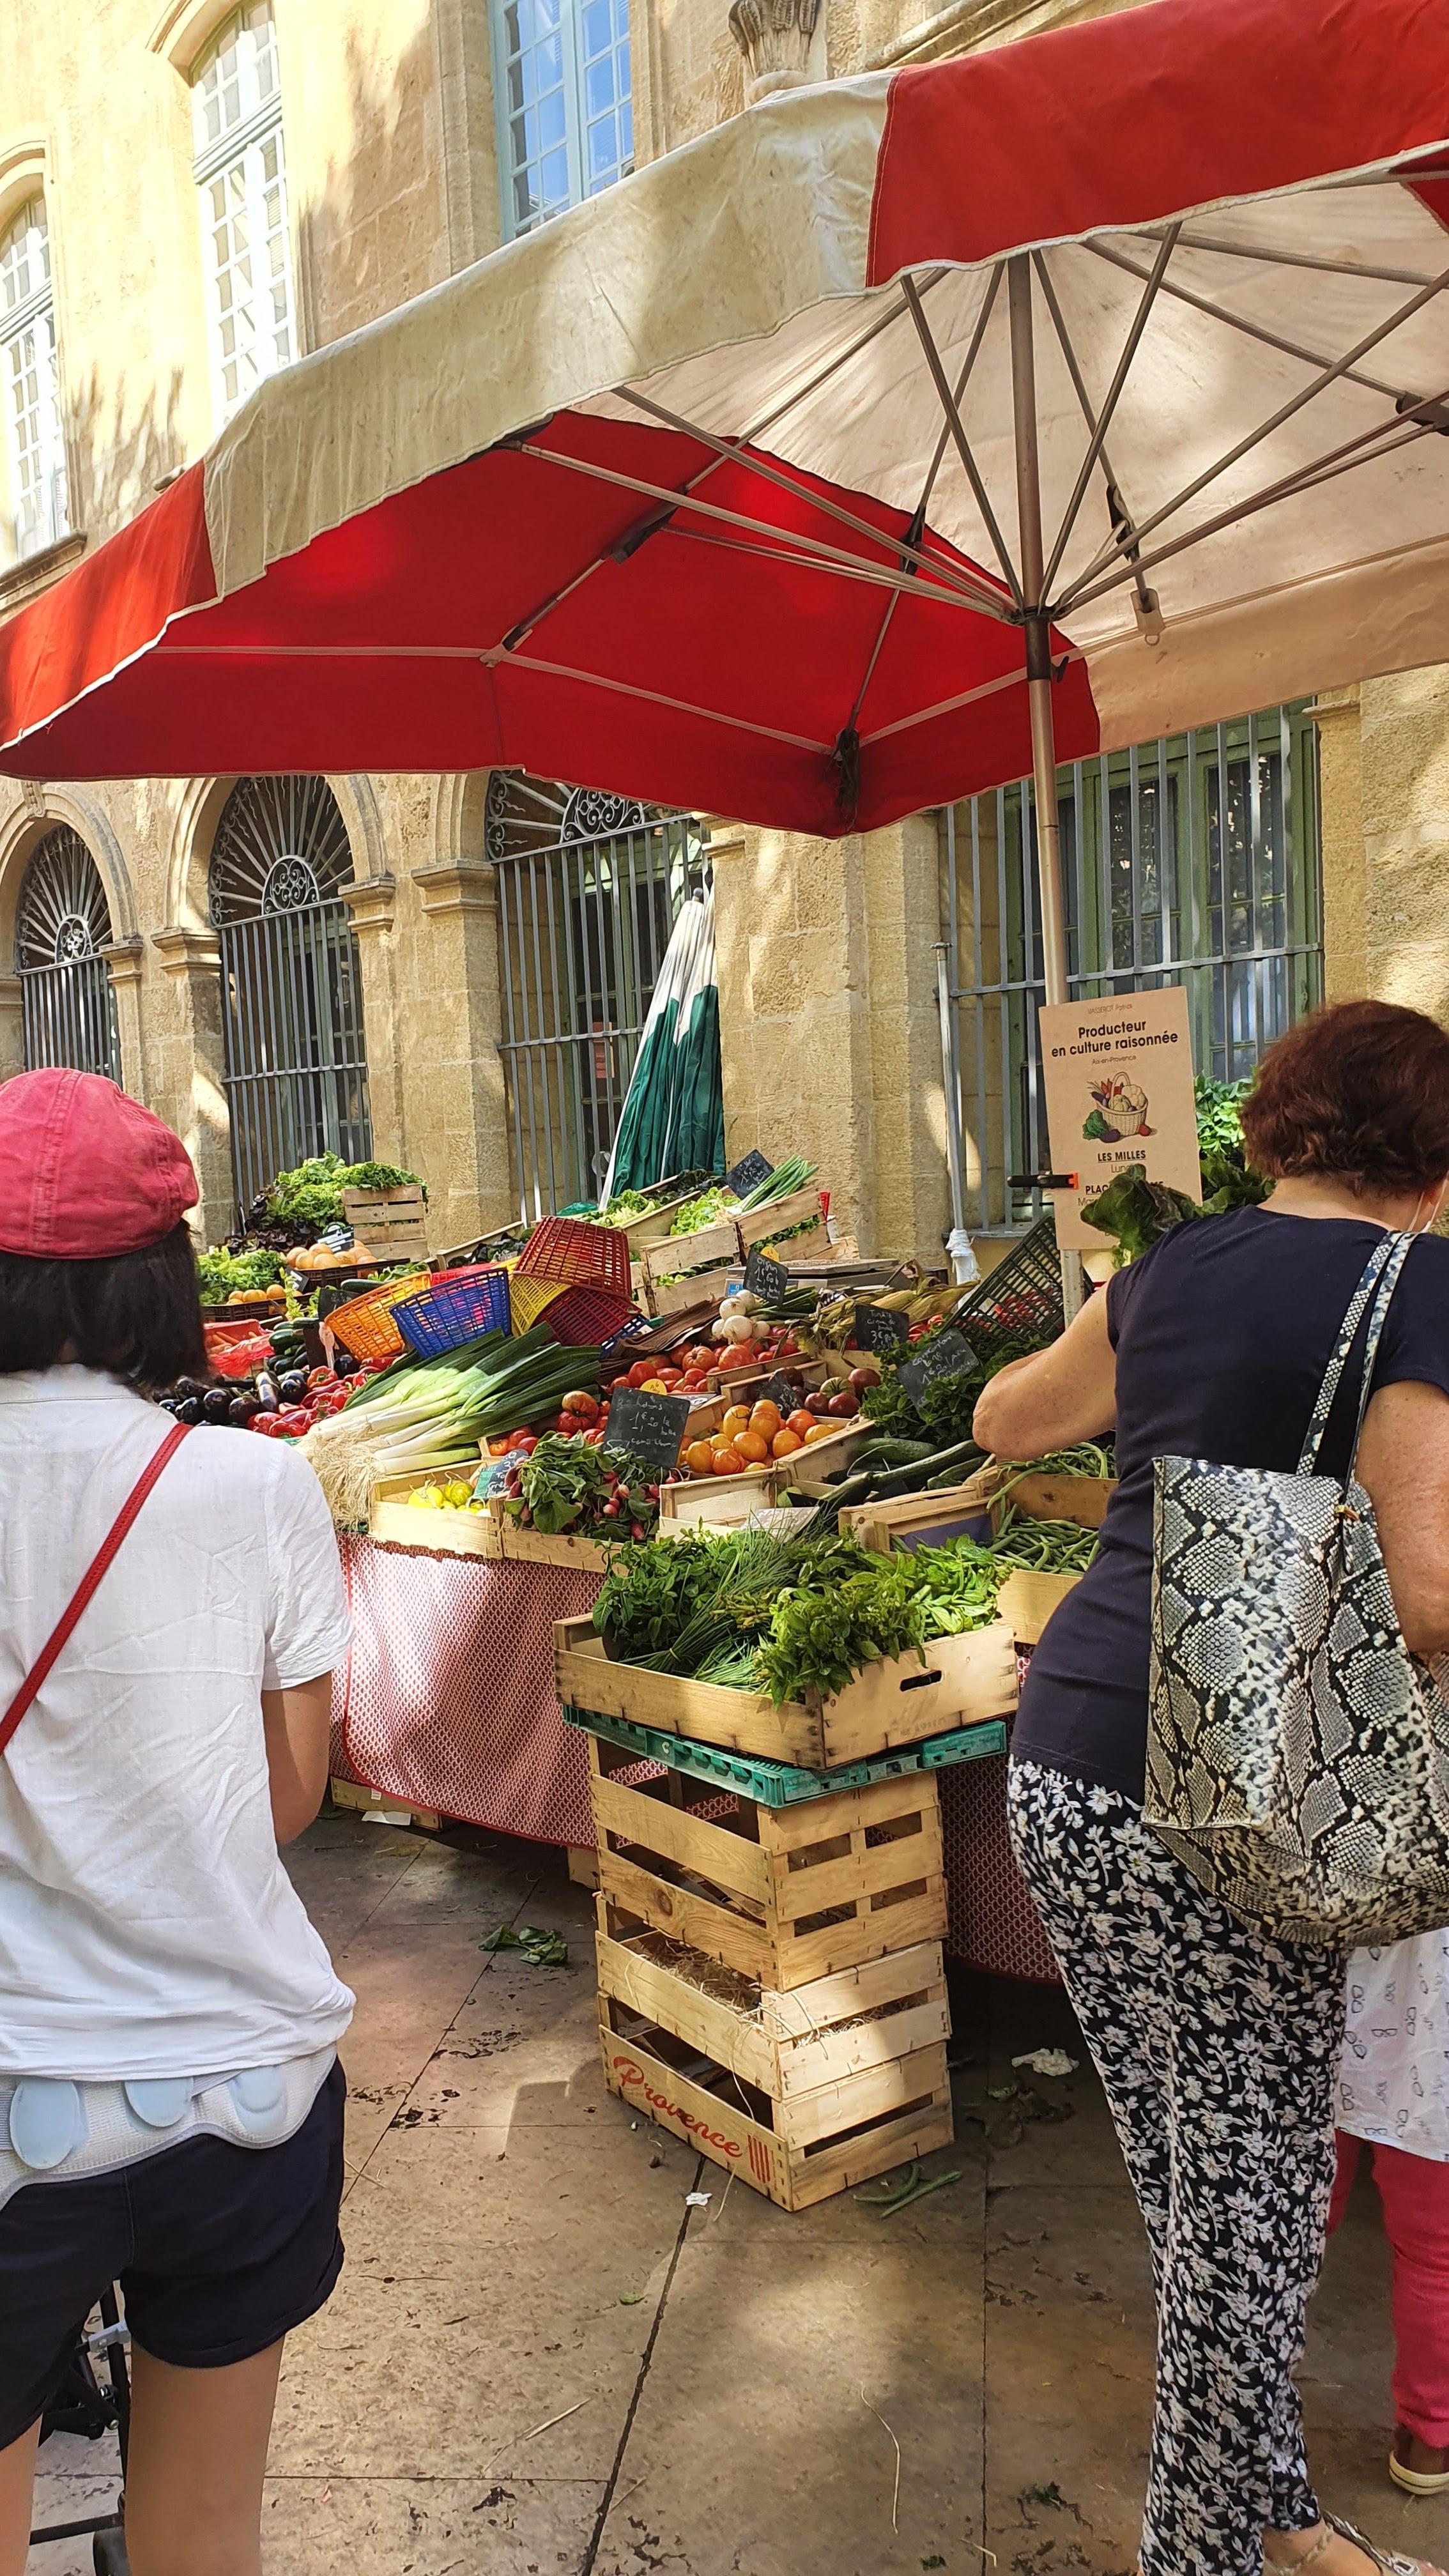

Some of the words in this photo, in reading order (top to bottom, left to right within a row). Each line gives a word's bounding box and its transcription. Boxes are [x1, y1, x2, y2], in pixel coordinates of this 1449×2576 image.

[1078, 1020, 1147, 1039] Producteur
[1051, 1047, 1066, 1057] en
[1069, 1041, 1112, 1055] culture
[1115, 1030, 1179, 1050] raisonnée
[1091, 1054, 1137, 1065] Aix-en-Provence
[1098, 1153, 1112, 1162] LES
[1115, 1150, 1146, 1161] MILLES
[1085, 1184, 1109, 1194] PLAC
[613, 2055, 743, 2158] Provence
